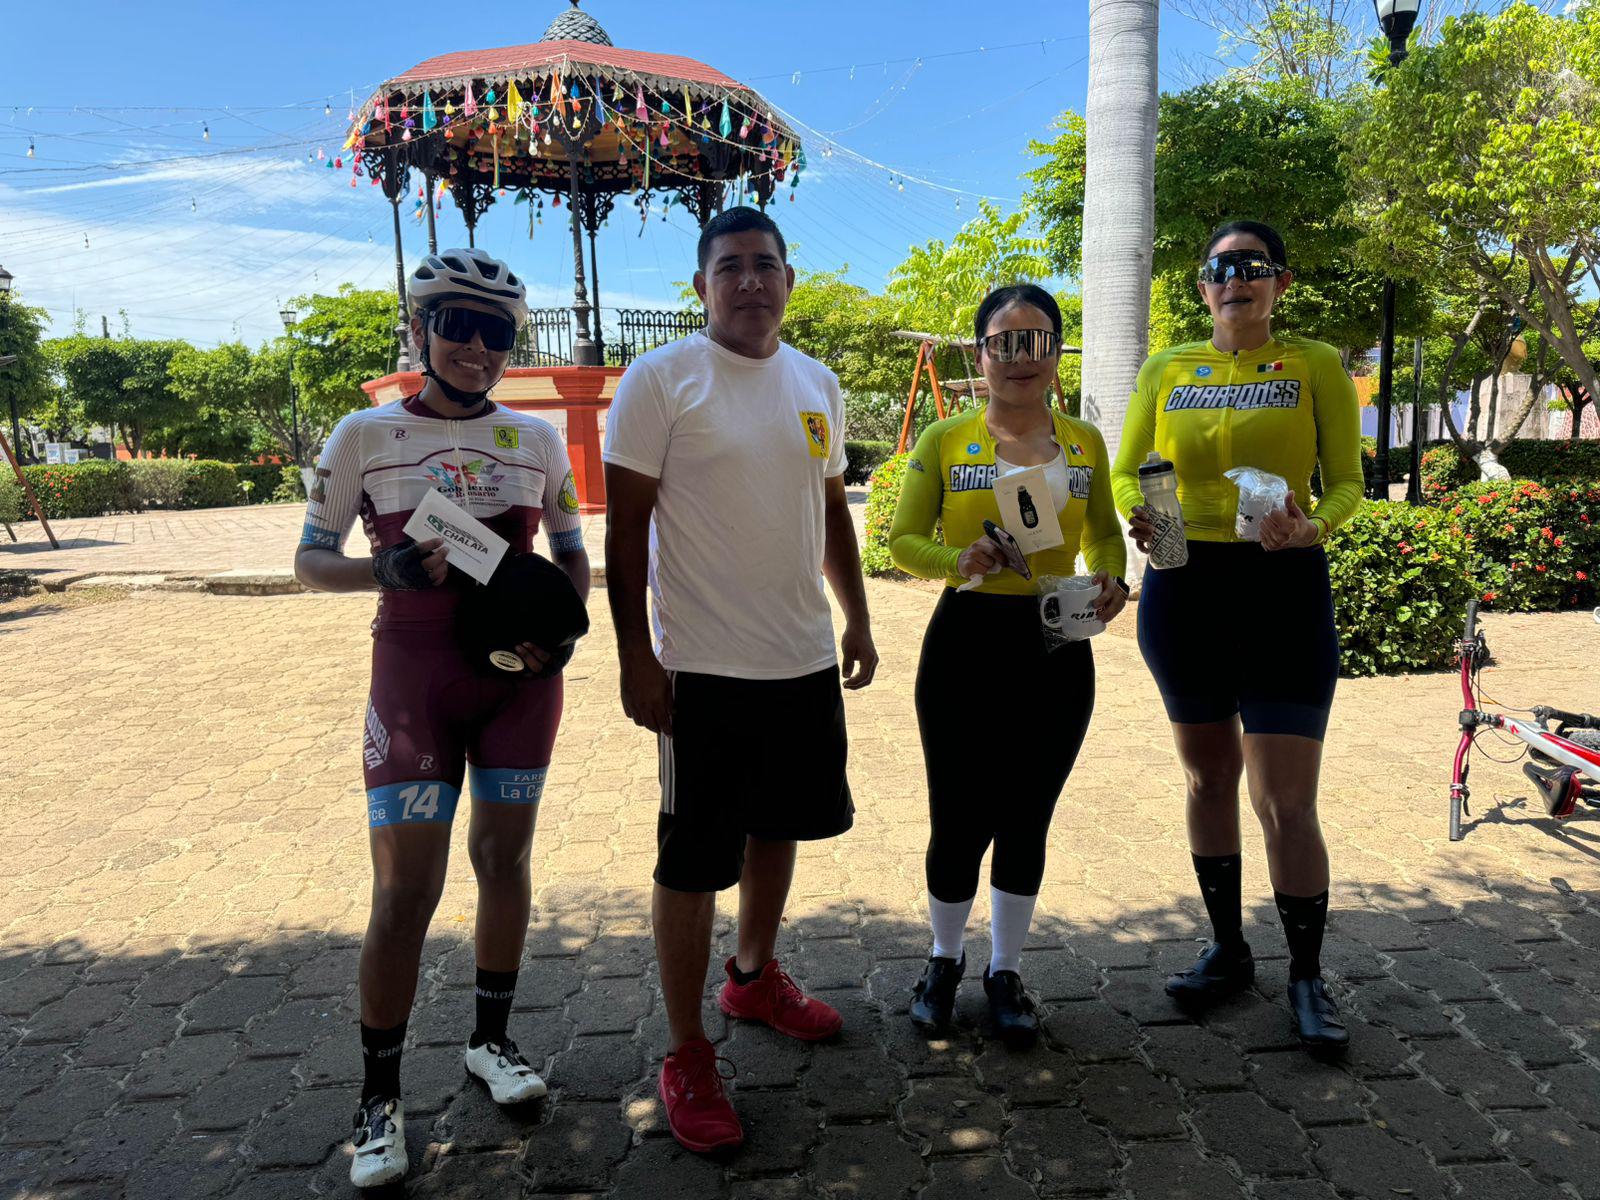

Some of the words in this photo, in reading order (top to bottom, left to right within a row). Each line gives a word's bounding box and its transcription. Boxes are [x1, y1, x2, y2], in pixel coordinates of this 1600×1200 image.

[1165, 380, 1300, 412] CIMARRONES
[443, 529, 489, 555] CHALATA
[500, 784, 520, 799] La
